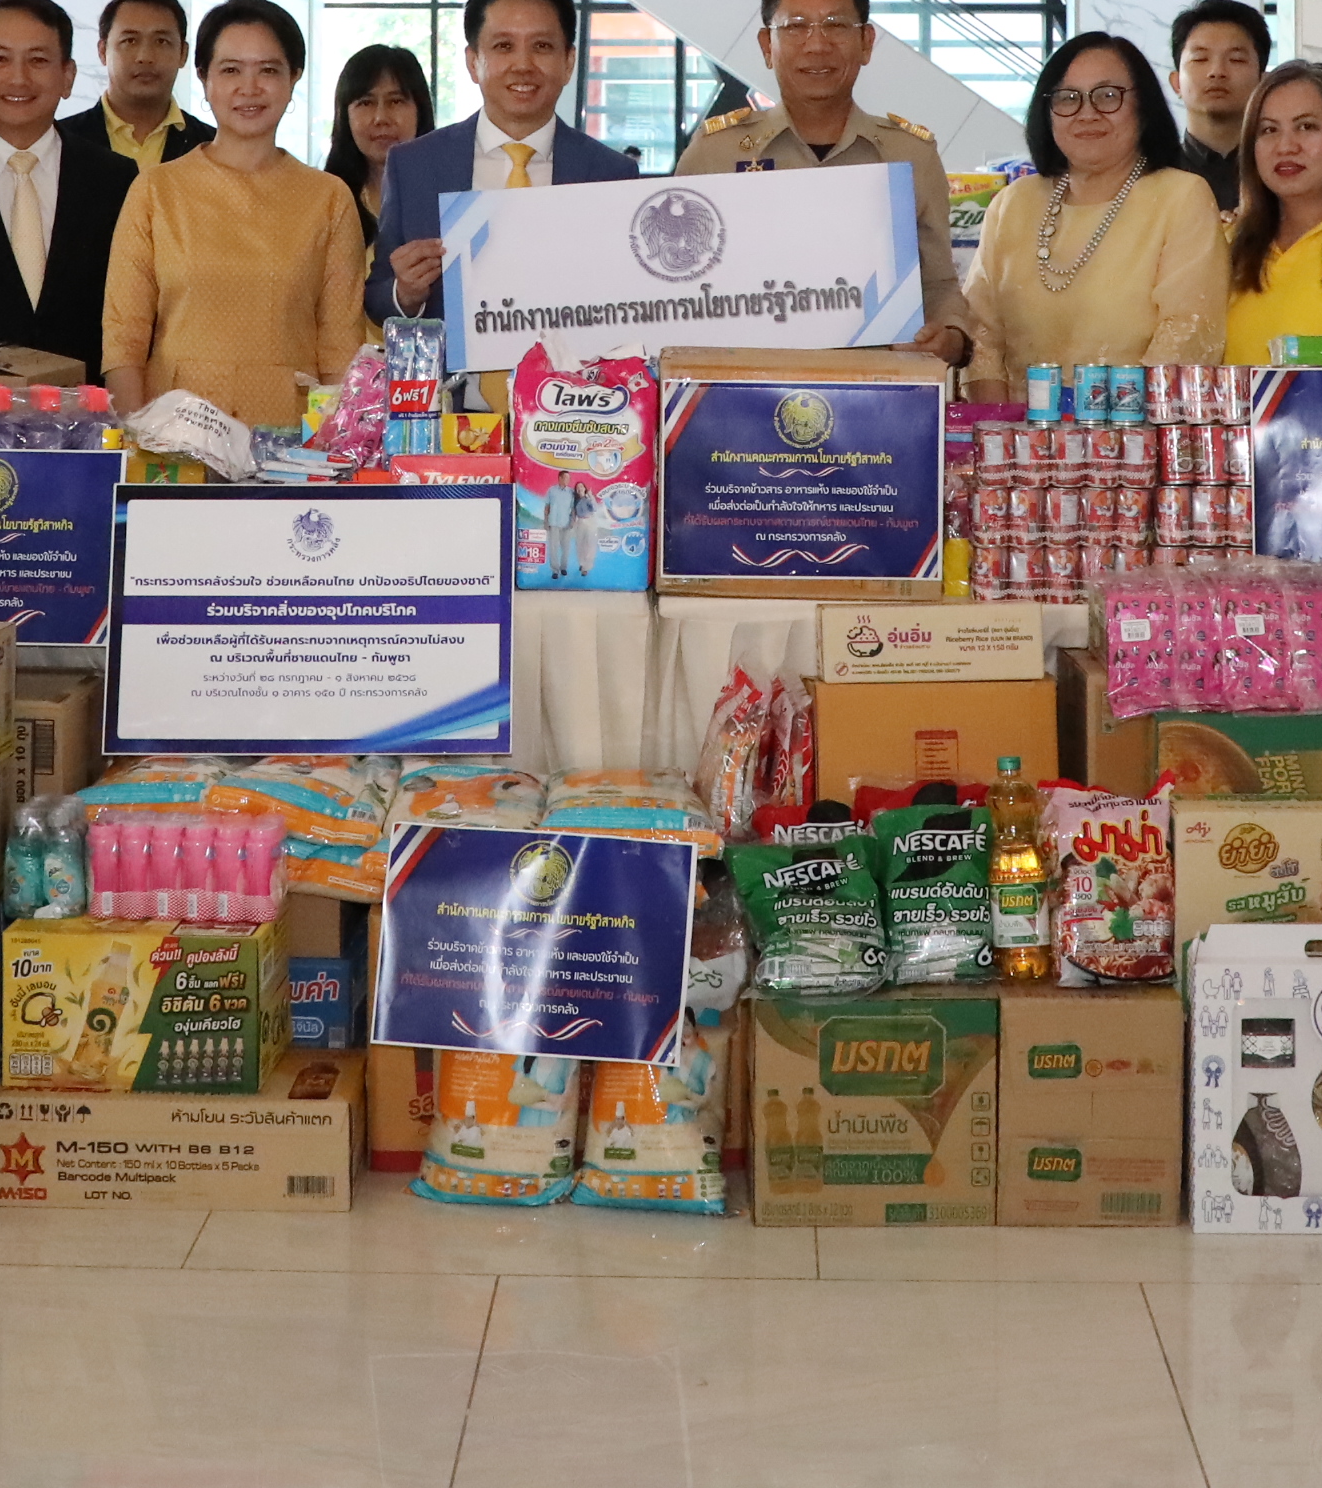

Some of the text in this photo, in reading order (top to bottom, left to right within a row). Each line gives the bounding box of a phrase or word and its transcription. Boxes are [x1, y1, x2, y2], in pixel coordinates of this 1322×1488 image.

[474, 278, 862, 334] สำนักงานคณะกรรมการนโยบายรัฐวิสาหกิจ
[199, 403, 218, 416] Thai
[705, 483, 897, 496] ร่วมบริจาคข้าวสาร อาหารแห้ง และของใช้จำเป็น
[709, 498, 893, 512] เพื่อส่งต่อเป็นกำลังใจให้ทหาร และประชาชน
[768, 530, 846, 542] กระทรวงการคลัง
[13, 552, 76, 562] และของใช้จำเป็น
[528, 546, 539, 558] 18
[19, 569, 71, 578] และประชาชน
[267, 575, 354, 587] ช่วยเหลือคนไทย
[206, 601, 417, 620] ร่วมบริจาคสิ่งของอุปโภคบริโภค
[156, 633, 465, 648] เพื่อช่วยเหลือผู้ที่ได้รับผลกระทบจากเหตุการณ์ความไม่สงบ
[887, 623, 932, 648] อุ่นอิ่ม
[227, 650, 357, 664] บริเวณพื้นที่ชายแดนไทย
[203, 672, 256, 683] ระหว่างวันที่
[278, 674, 323, 685] กรกฎาคม
[346, 672, 384, 683] สิงหาคม
[283, 689, 310, 698] อาคาร
[893, 823, 987, 855] NESCAFÉ
[1073, 809, 1164, 862] มาม่า
[1219, 831, 1279, 869] ยำยำ
[906, 855, 935, 863] BLEND
[945, 854, 972, 862] BREW
[763, 853, 862, 890] NESCAFÉ
[824, 878, 848, 891] BREW
[891, 882, 983, 900] แบรนด์อันดับ
[1002, 895, 1033, 908] มรกต
[893, 905, 946, 923] ขายเร็ว
[186, 944, 241, 969] คูปองลังนี้
[11, 960, 52, 978] 10 บาท
[176, 972, 188, 990] 6
[161, 995, 247, 1013] อิชิตัน ขวด
[174, 1018, 242, 1037] องุ่นเคียวโฮ
[830, 1041, 932, 1074] มรกต
[1033, 1053, 1076, 1070] มรกต
[171, 1108, 225, 1125] ห้ามโยน
[826, 1111, 909, 1136] น้ำมันพืช
[56, 1141, 255, 1155] M-150 WITH B6 B12
[10, 1148, 35, 1170] M
[57, 1159, 75, 1169] Net
[78, 1159, 117, 1169] Content
[165, 1161, 176, 1169] 10
[177, 1161, 212, 1171] Bottles
[214, 1163, 220, 1171] x
[222, 1162, 230, 1171] 5
[231, 1162, 260, 1171] Packs
[1033, 1156, 1076, 1172] มรกต
[57, 1172, 176, 1183] Barcode Multipack
[871, 1167, 918, 1183] 100%
[85, 1190, 133, 1201] LOT NO.
